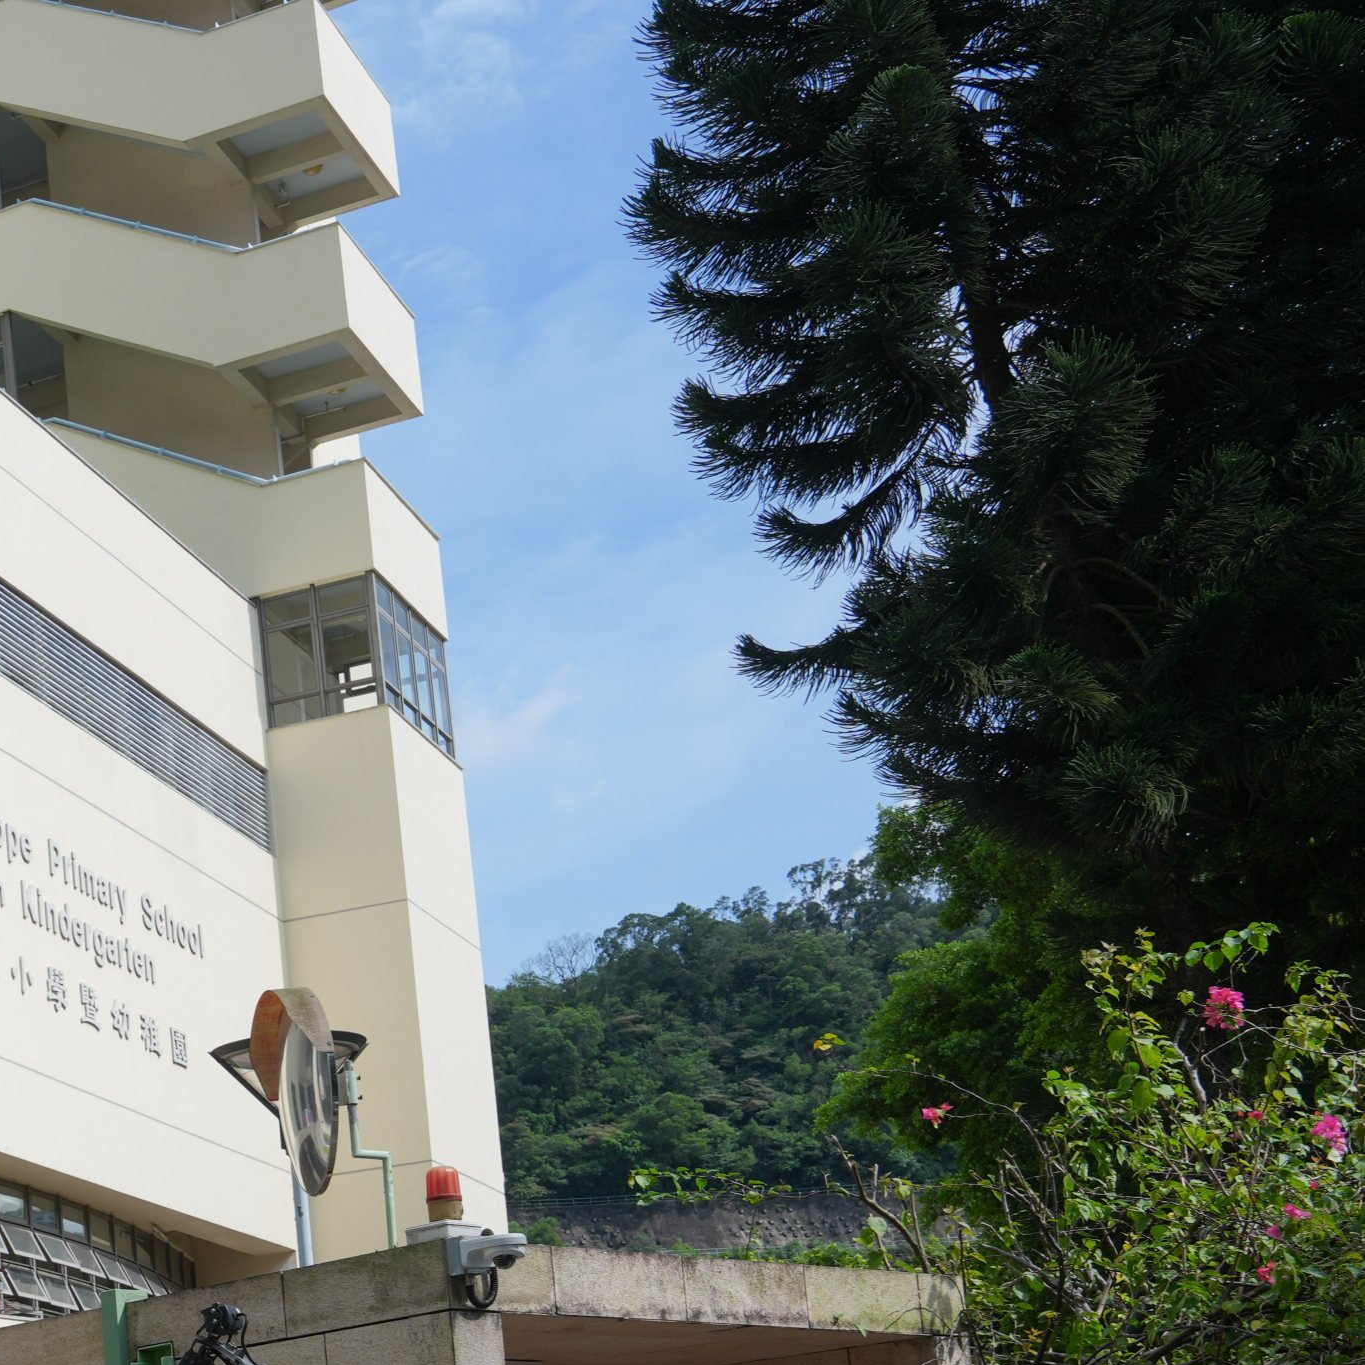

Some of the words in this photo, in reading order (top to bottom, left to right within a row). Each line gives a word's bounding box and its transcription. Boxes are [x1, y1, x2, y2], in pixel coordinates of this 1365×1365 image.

[20, 879, 157, 985] Kindergarten
[47, 838, 128, 925] Primary
[140, 893, 205, 958] School
